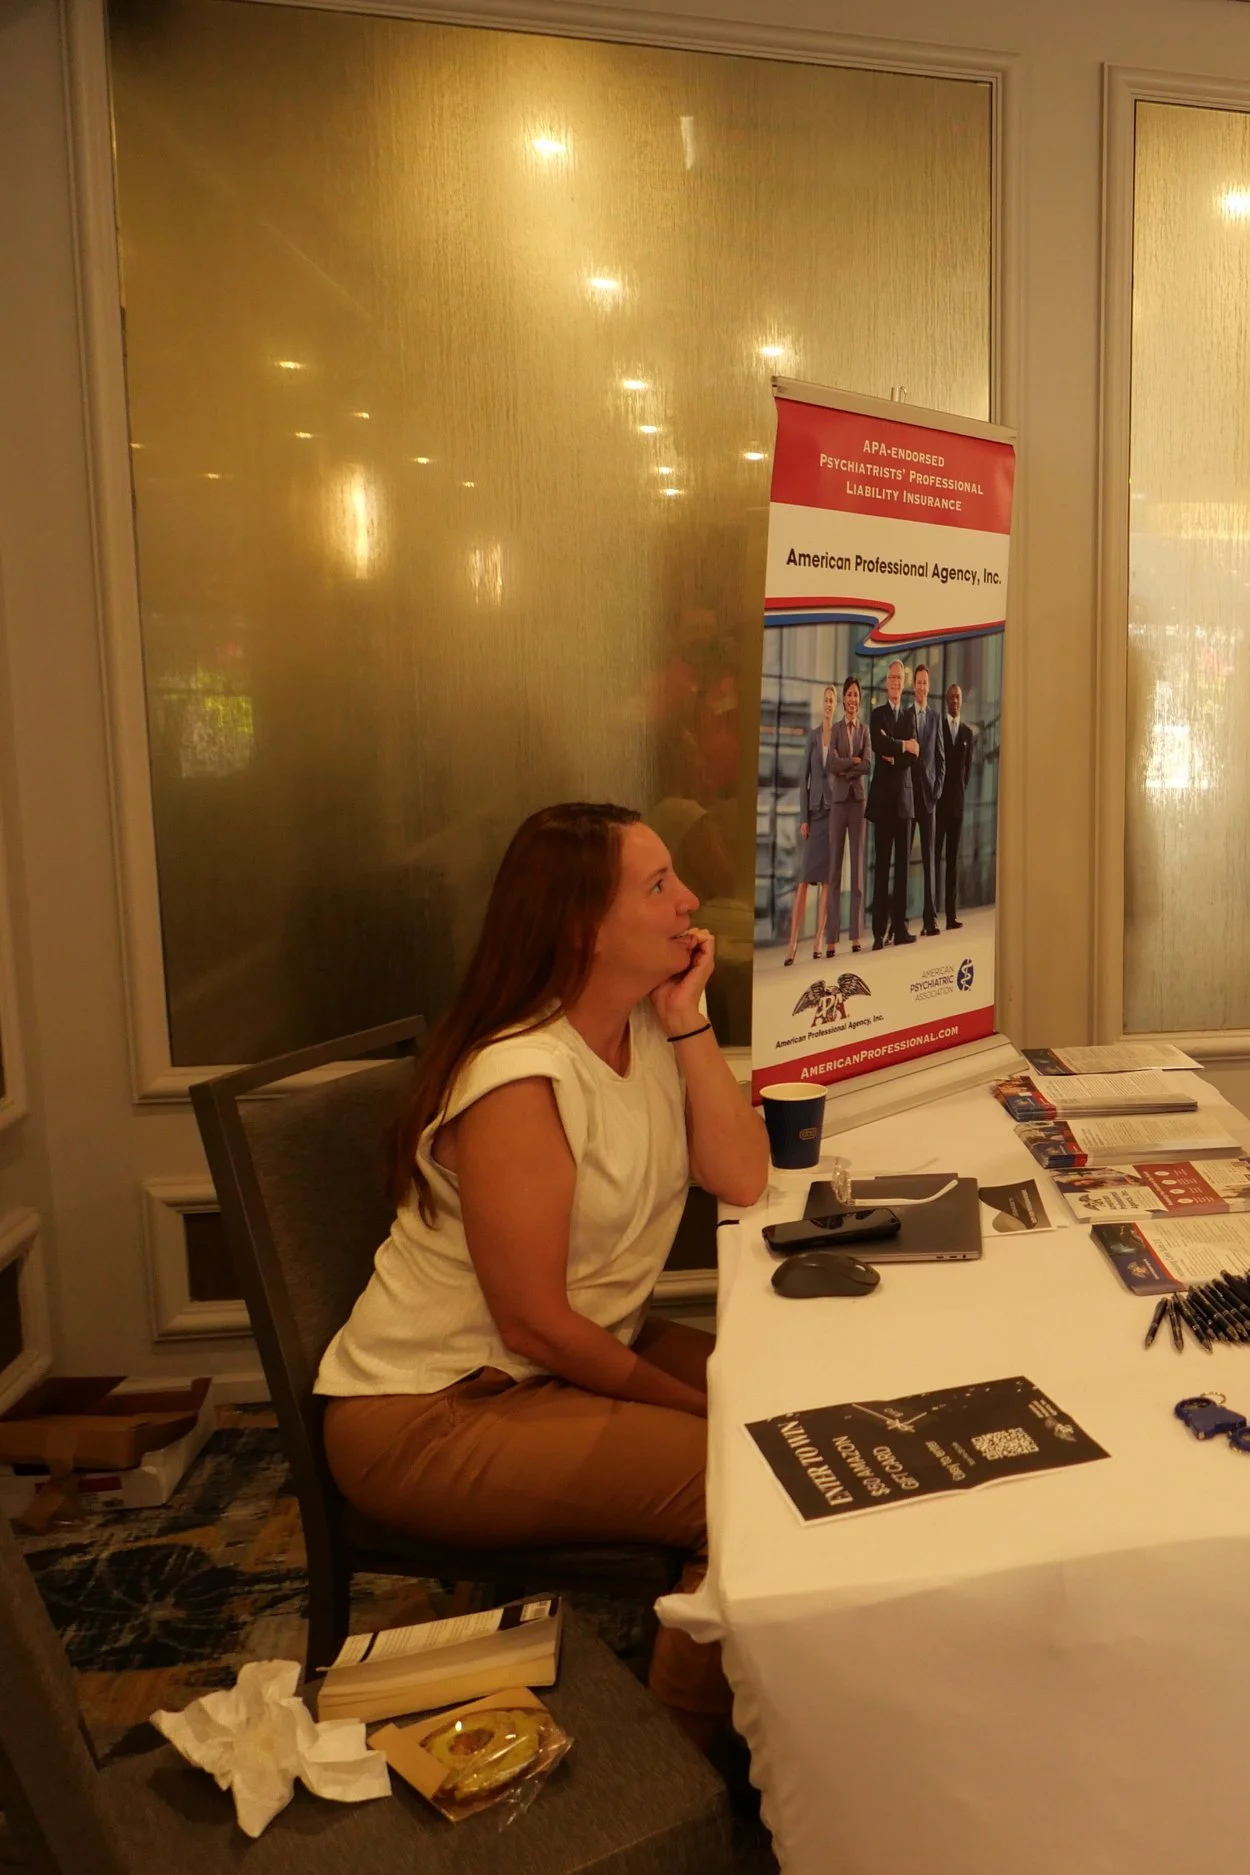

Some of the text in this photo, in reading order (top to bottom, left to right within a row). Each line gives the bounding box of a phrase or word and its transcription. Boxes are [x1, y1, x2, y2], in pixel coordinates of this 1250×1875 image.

[863, 440, 945, 468] APA-ENDORSED
[846, 481, 962, 512] LIABILITY INSURANCE
[909, 470, 984, 495] PROFESSIONAL
[786, 548, 1002, 586] American Professional Agency, Inc.
[910, 975, 954, 992] PSYCHIATRIC
[922, 965, 954, 979] AMERICAN
[915, 986, 954, 1001] ASSOCIATION
[775, 1014, 884, 1050] American Professional Agency, Inc.
[777, 1420, 854, 1506] ENTER TO WIN
[832, 1435, 891, 1497] $50 AMAZON
[872, 1446, 920, 1490] GIFT CARD
